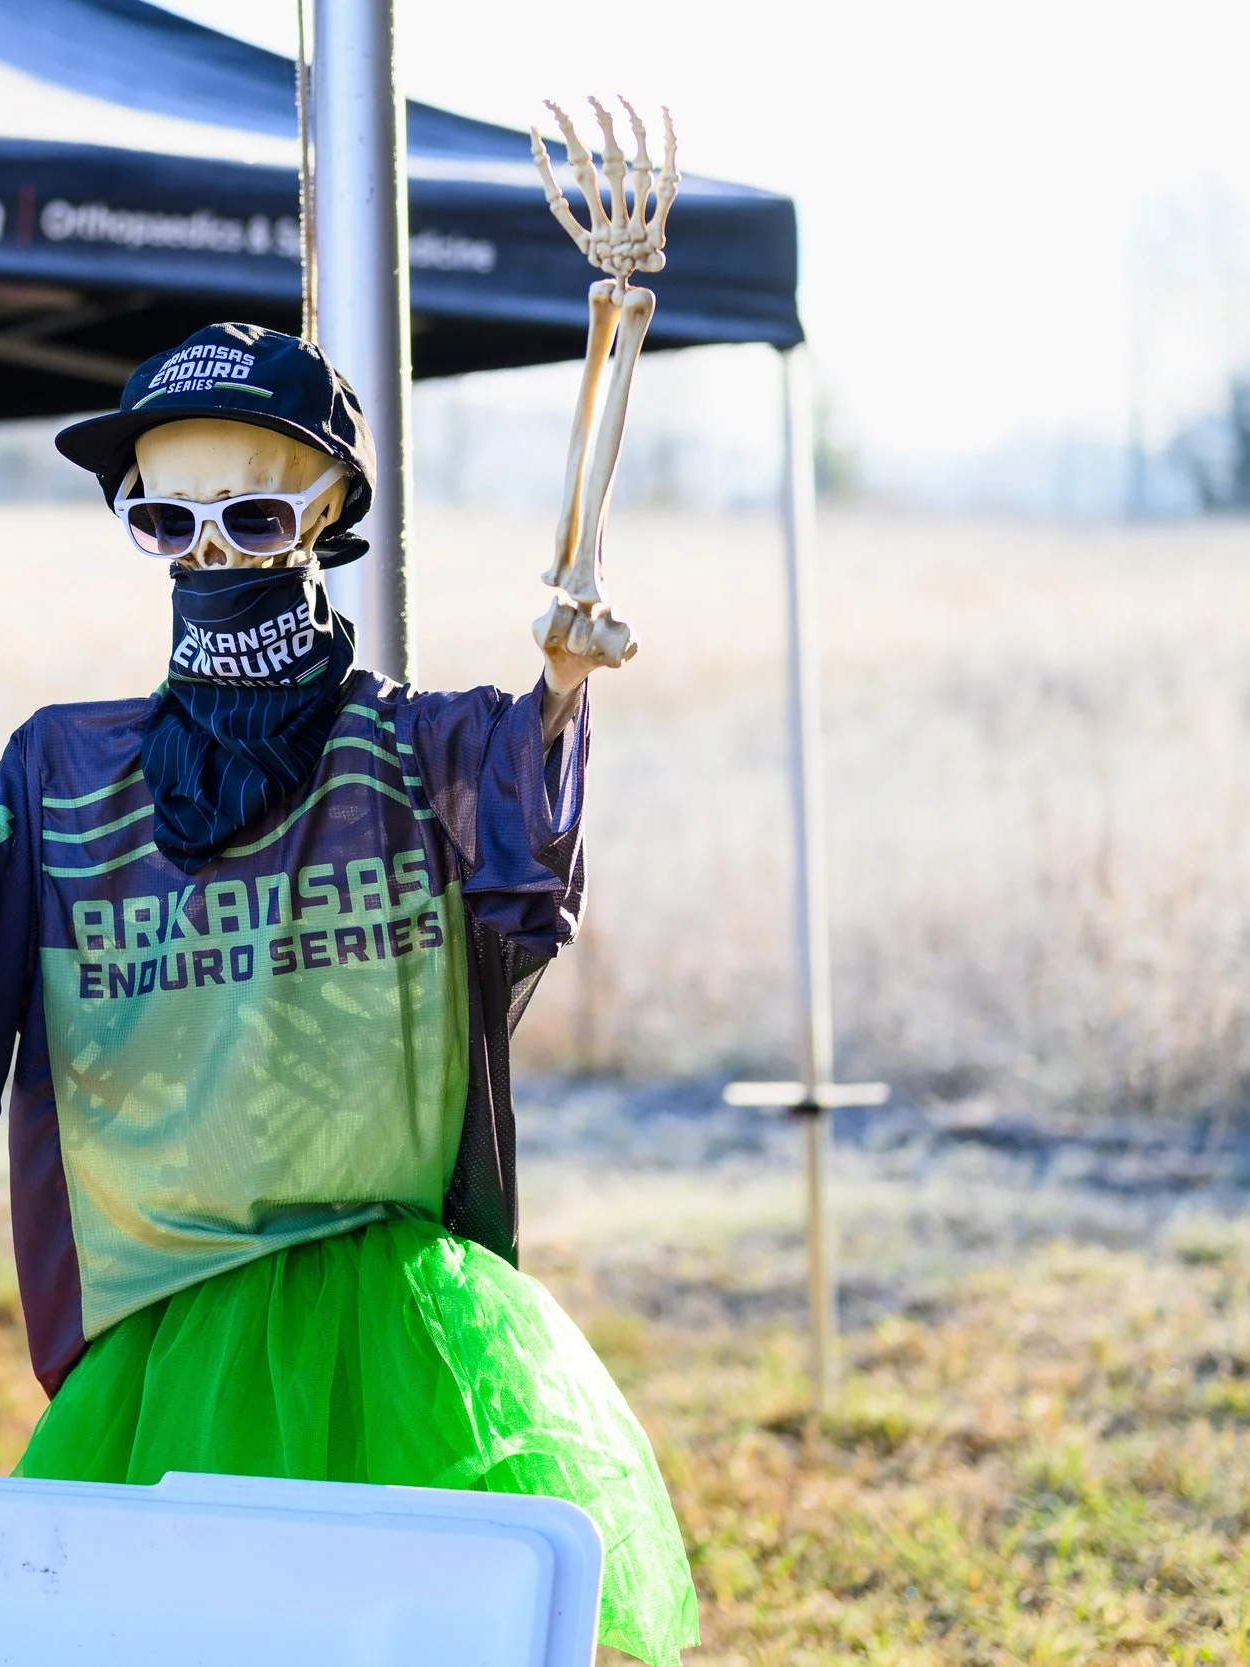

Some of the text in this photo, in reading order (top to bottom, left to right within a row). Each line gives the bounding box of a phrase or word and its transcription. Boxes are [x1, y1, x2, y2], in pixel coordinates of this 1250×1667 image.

[148, 361, 250, 389] ENDURO
[158, 345, 256, 373] ARKANSAS
[167, 379, 214, 394] SERIES
[172, 628, 315, 678] ENDURO
[182, 602, 311, 655] RKANSAS
[72, 848, 434, 952] ARKANSAS
[79, 911, 445, 999] ENDURO SERIES
